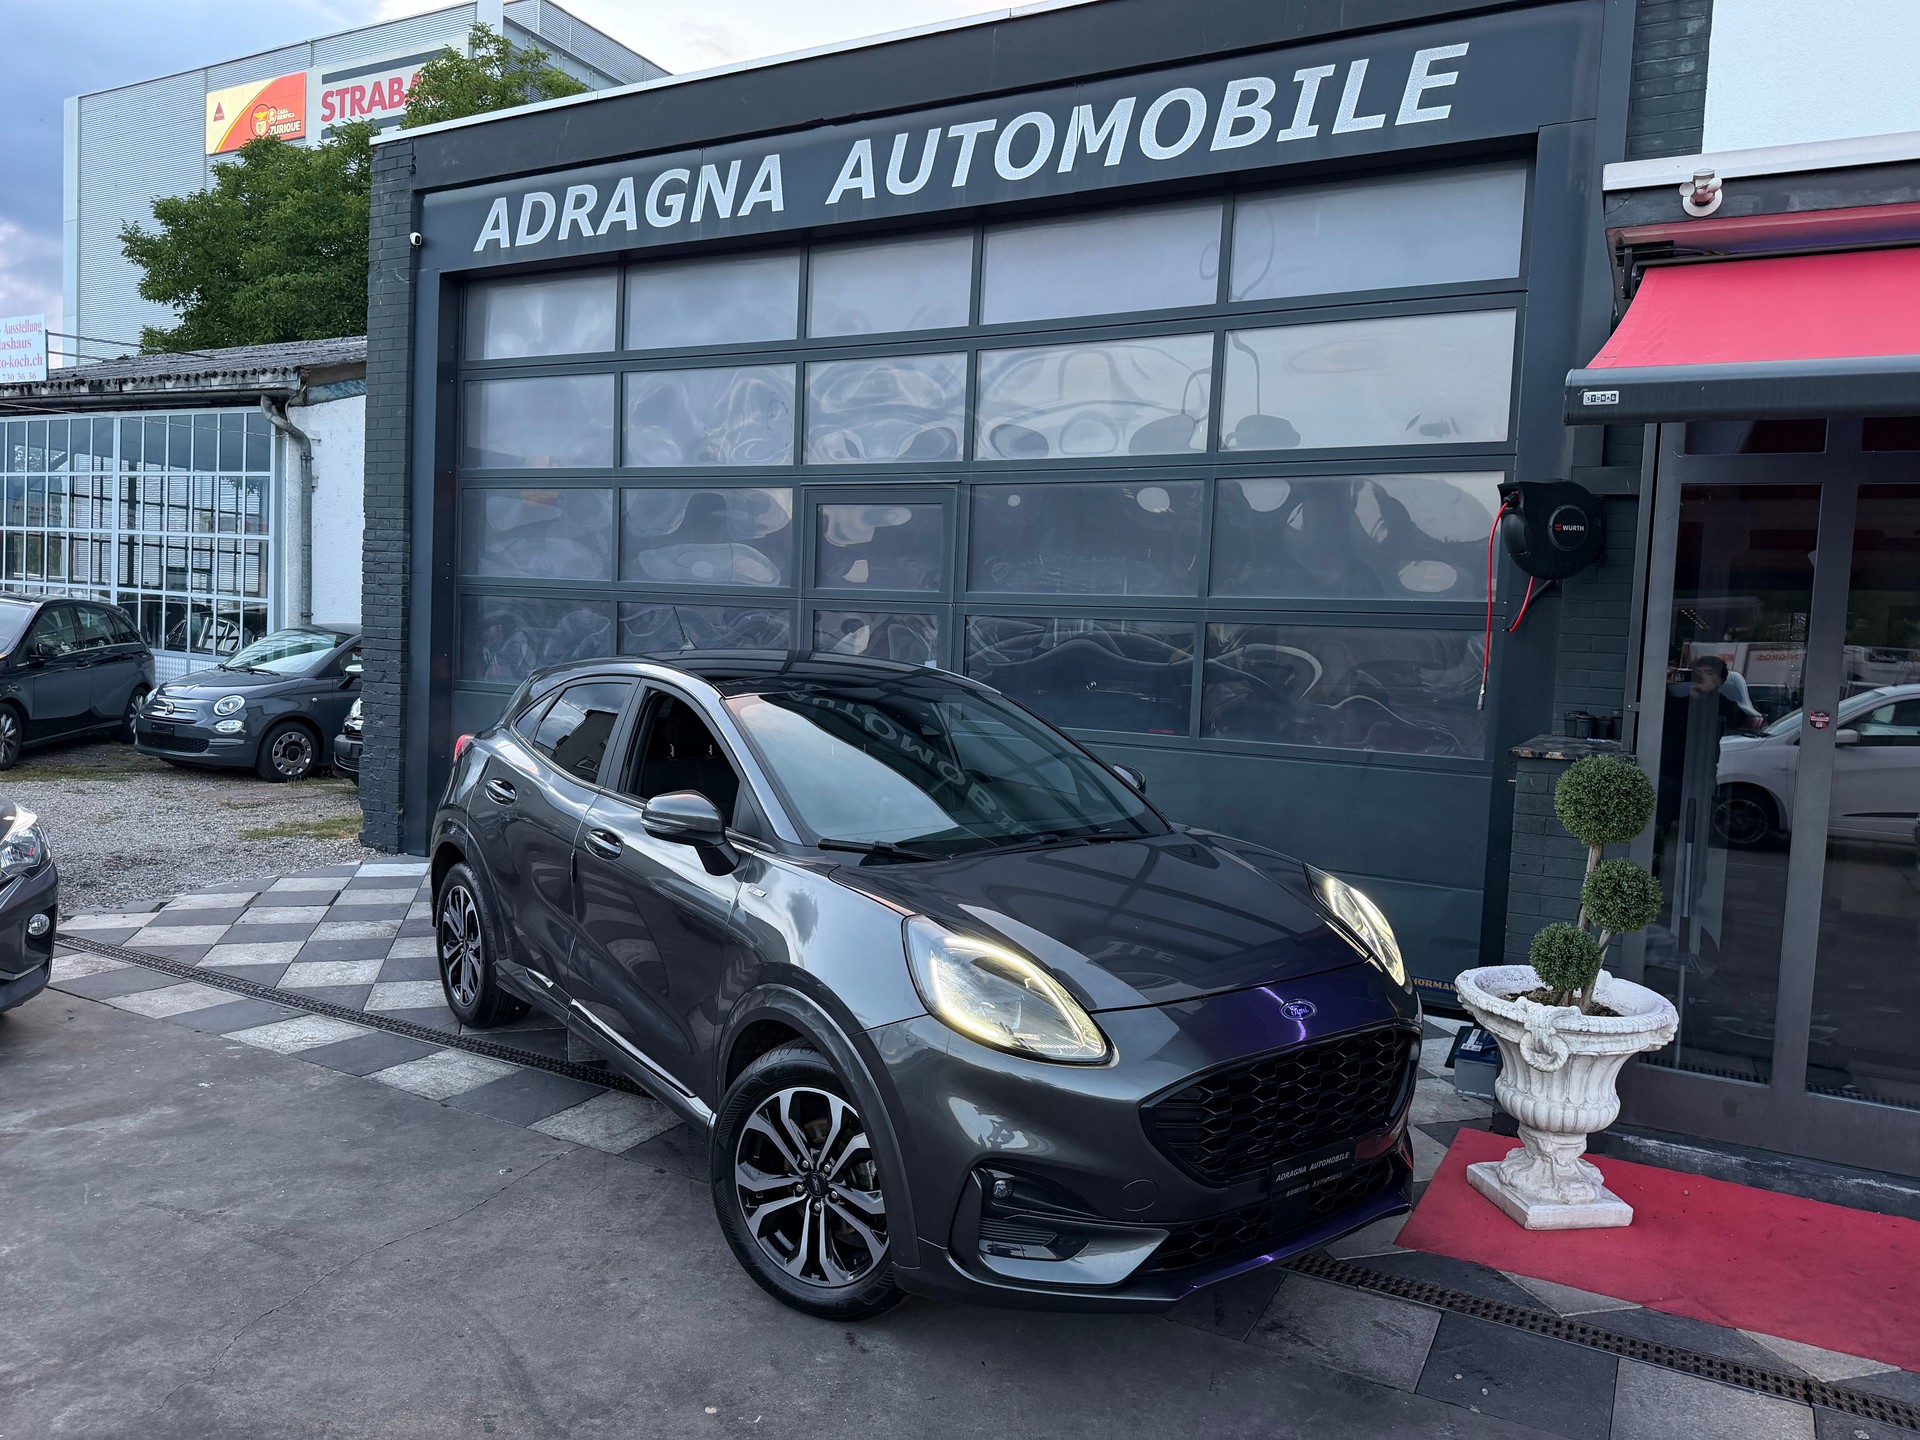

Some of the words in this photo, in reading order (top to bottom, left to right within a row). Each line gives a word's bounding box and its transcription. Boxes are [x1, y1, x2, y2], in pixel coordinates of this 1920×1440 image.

[269, 120, 301, 135] ZURIQUE
[473, 153, 785, 252] ADRAGNA
[825, 42, 1470, 205] AUTOMOBILE
[4, 319, 43, 335] Ausstellung
[2, 373, 15, 381] 730
[17, 372, 26, 380] 36
[28, 371, 37, 379] 36
[1275, 1165, 1307, 1183] ADRAGNA
[1308, 1151, 1351, 1171] AUTOMOBILE
